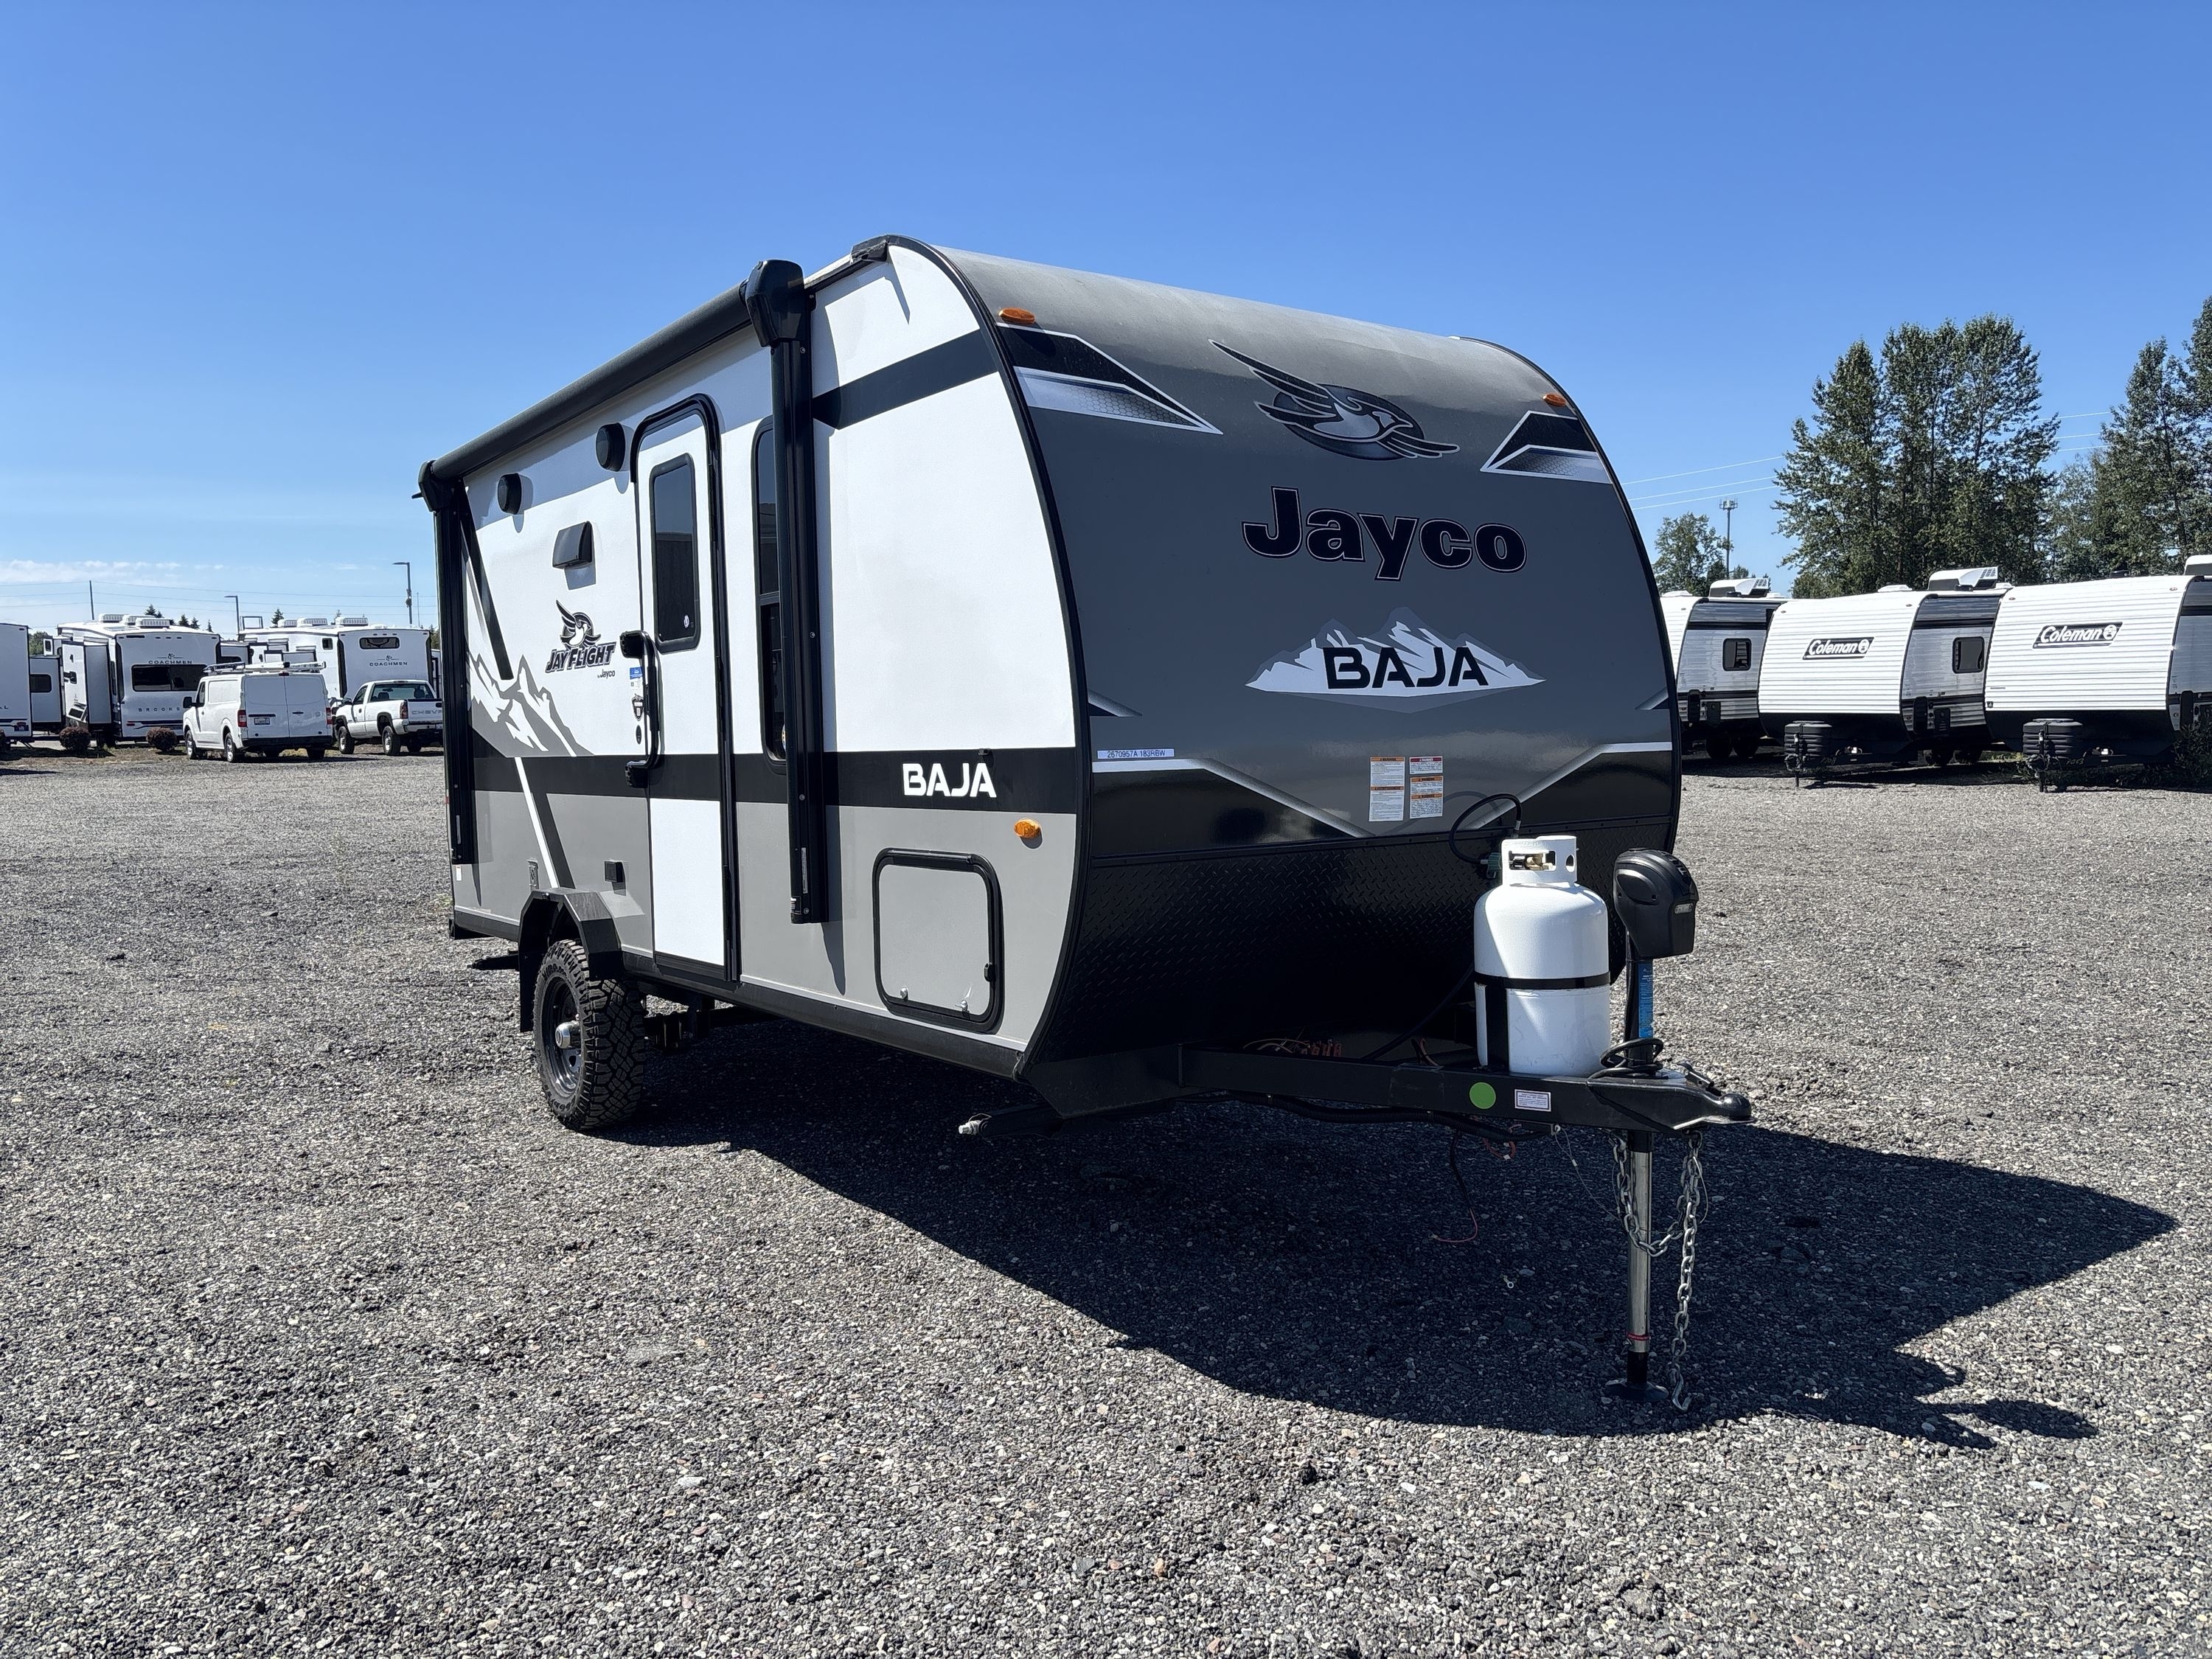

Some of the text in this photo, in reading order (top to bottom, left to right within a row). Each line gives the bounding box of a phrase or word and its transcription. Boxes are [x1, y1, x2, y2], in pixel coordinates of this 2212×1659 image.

[1241, 485, 1528, 582] Jayco
[2040, 625, 2103, 643] Coleman
[546, 642, 616, 673] JAY FLIGHT
[1809, 639, 1858, 655] Coleman
[600, 669, 616, 679] Jayco
[1323, 647, 1489, 689] BAJA
[1107, 750, 1138, 759] 2670957A
[902, 762, 997, 798] BAJA
